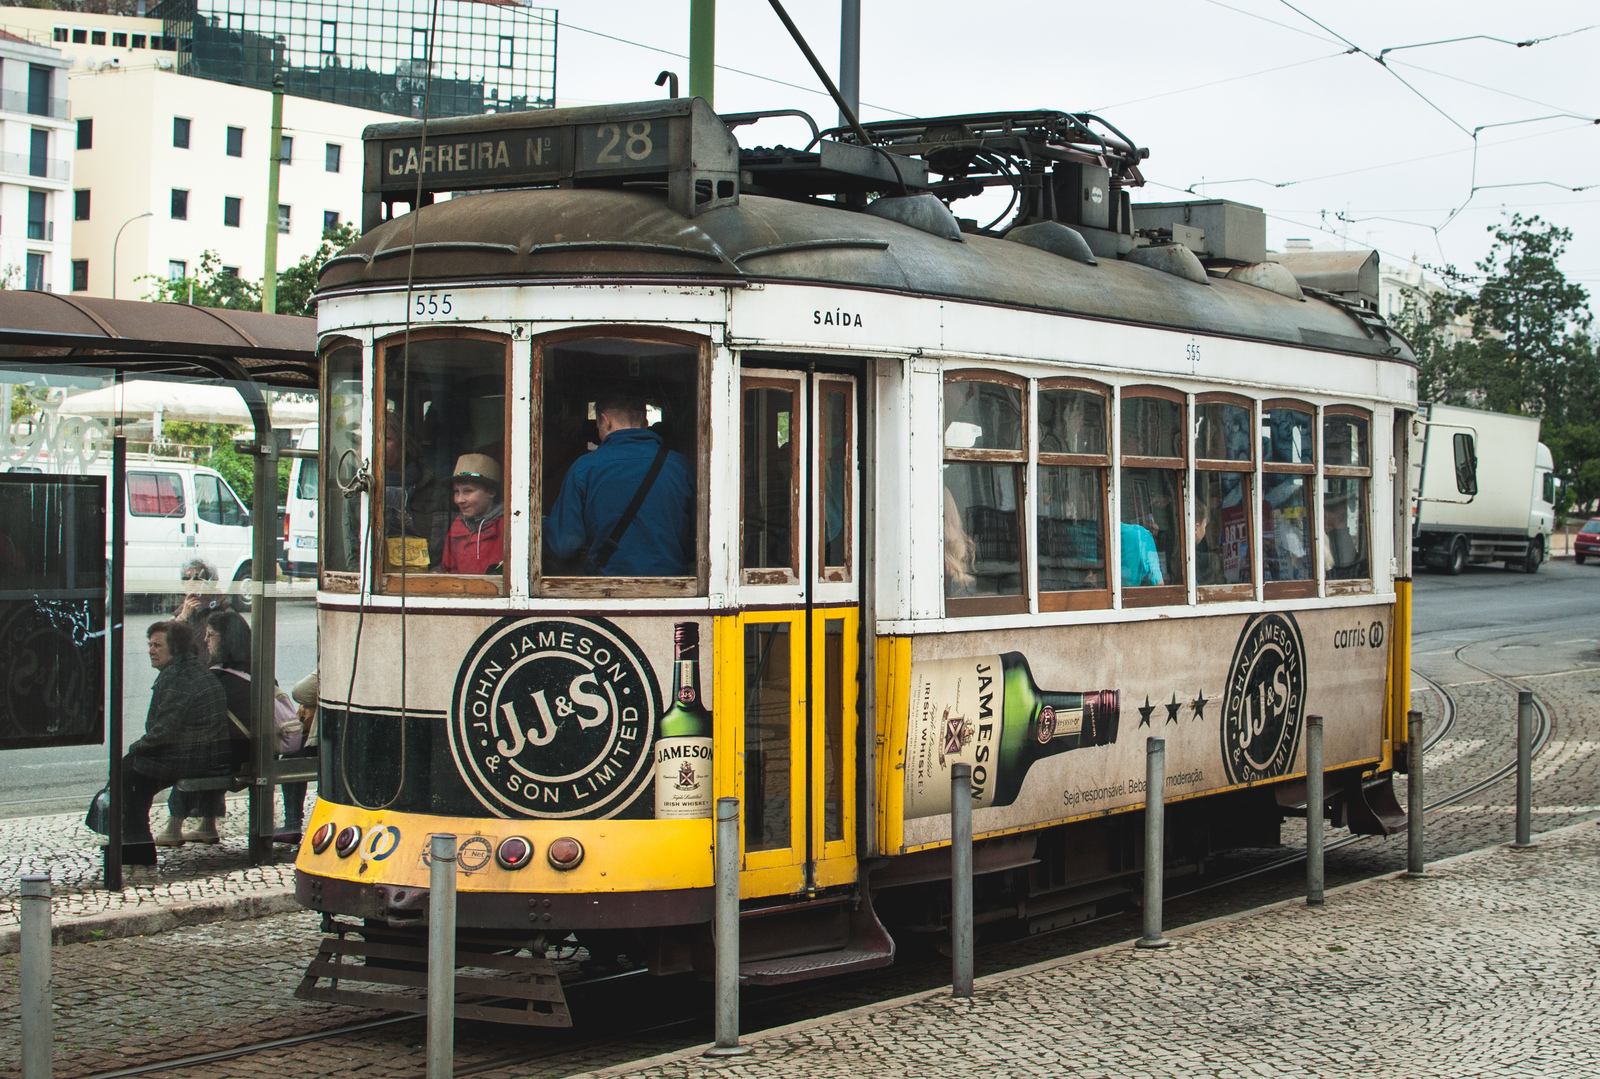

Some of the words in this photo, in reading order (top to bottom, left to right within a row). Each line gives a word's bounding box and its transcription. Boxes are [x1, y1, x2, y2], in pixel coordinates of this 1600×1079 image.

[388, 139, 510, 176] CARREIRA
[595, 121, 653, 164] 28
[416, 294, 452, 315] 555
[813, 307, 863, 328] SAÍDA
[1186, 343, 1201, 361] 555
[1333, 620, 1366, 649] carris
[472, 659, 503, 733] JOHN
[509, 630, 627, 683] JAMESON
[1230, 655, 1250, 725] JOHN
[1253, 623, 1297, 672] JAMESON
[922, 682, 931, 722] IRISH
[970, 663, 993, 801] JAMESON
[506, 774, 559, 803] SON
[572, 706, 639, 800] LIMITED
[917, 728, 928, 796] WHISKEY
[1063, 789, 1080, 808] Seja
[1082, 780, 1126, 802] responsável.
